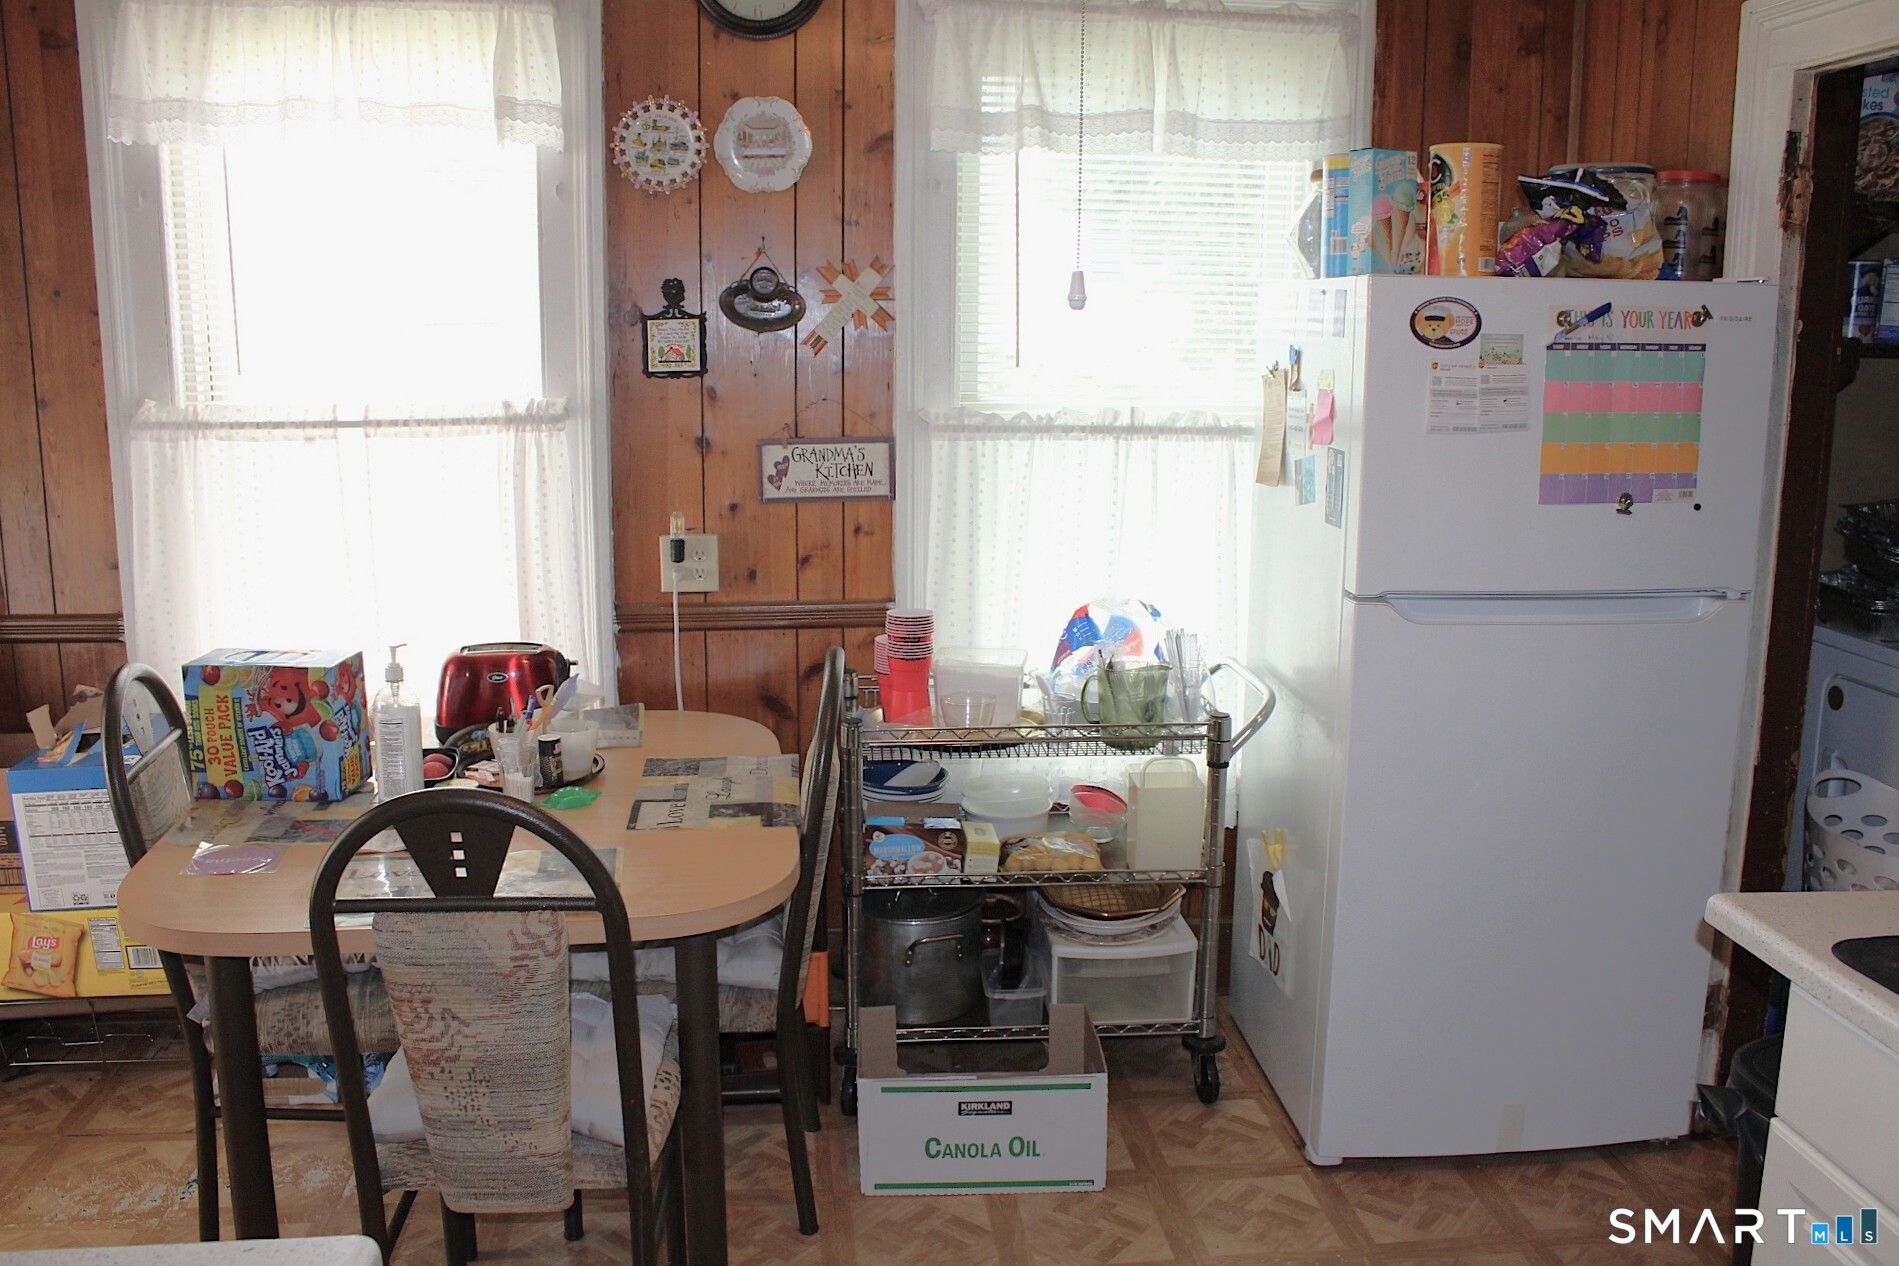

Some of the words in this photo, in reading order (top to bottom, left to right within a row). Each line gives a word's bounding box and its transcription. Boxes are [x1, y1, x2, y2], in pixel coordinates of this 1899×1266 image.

[1621, 310, 1654, 329] YOUR
[1659, 309, 1692, 330] YEAR
[791, 445, 865, 464] GRANDMA'S
[815, 462, 874, 480] KITCHEN
[216, 694, 232, 729] PACK
[204, 708, 218, 743] POUCH
[206, 746, 221, 765] 30
[220, 734, 238, 777] VALUE
[270, 727, 298, 777] Jammers
[656, 803, 686, 827] Love
[32, 935, 57, 950] Lay's
[960, 1102, 1010, 1111] KIRKLAND
[924, 1137, 1002, 1159] CANOLA
[1008, 1136, 1040, 1157] OIL
